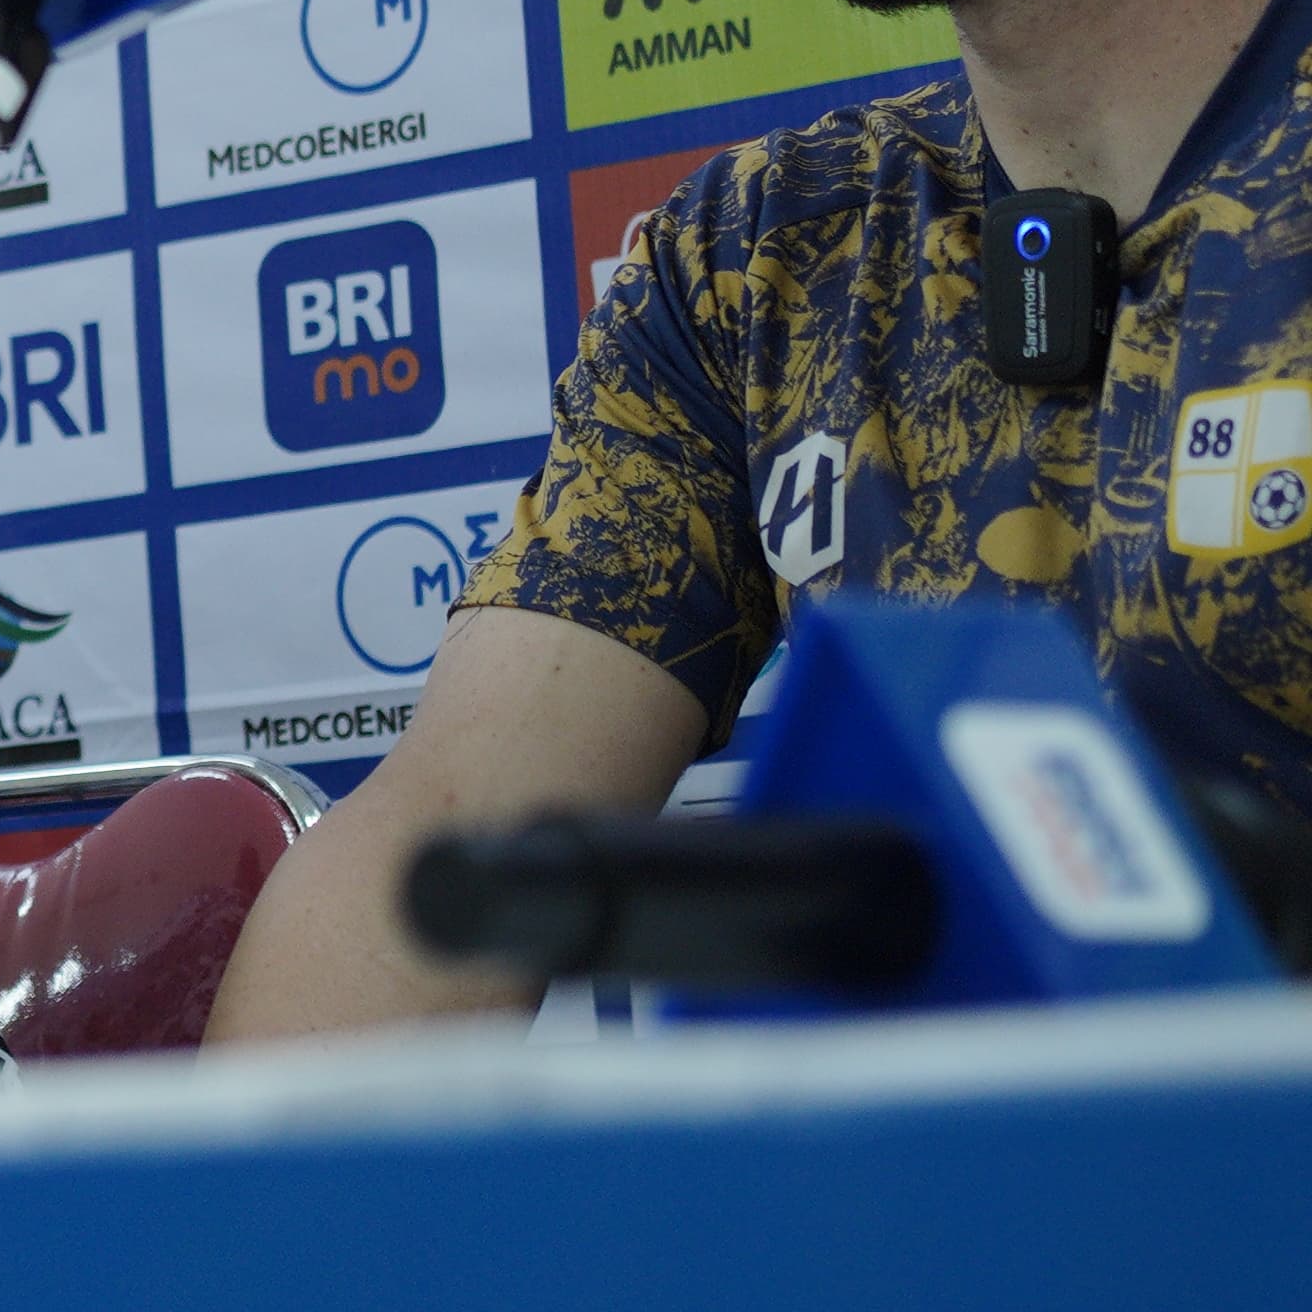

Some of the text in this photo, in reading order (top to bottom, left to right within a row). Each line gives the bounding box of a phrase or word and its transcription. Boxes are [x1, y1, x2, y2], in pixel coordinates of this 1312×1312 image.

[608, 17, 752, 77] AMMAN
[284, 264, 413, 357] BRI
[1020, 267, 1040, 359] Saramonic
[313, 347, 422, 406] mo
[1187, 416, 1237, 461] 88
